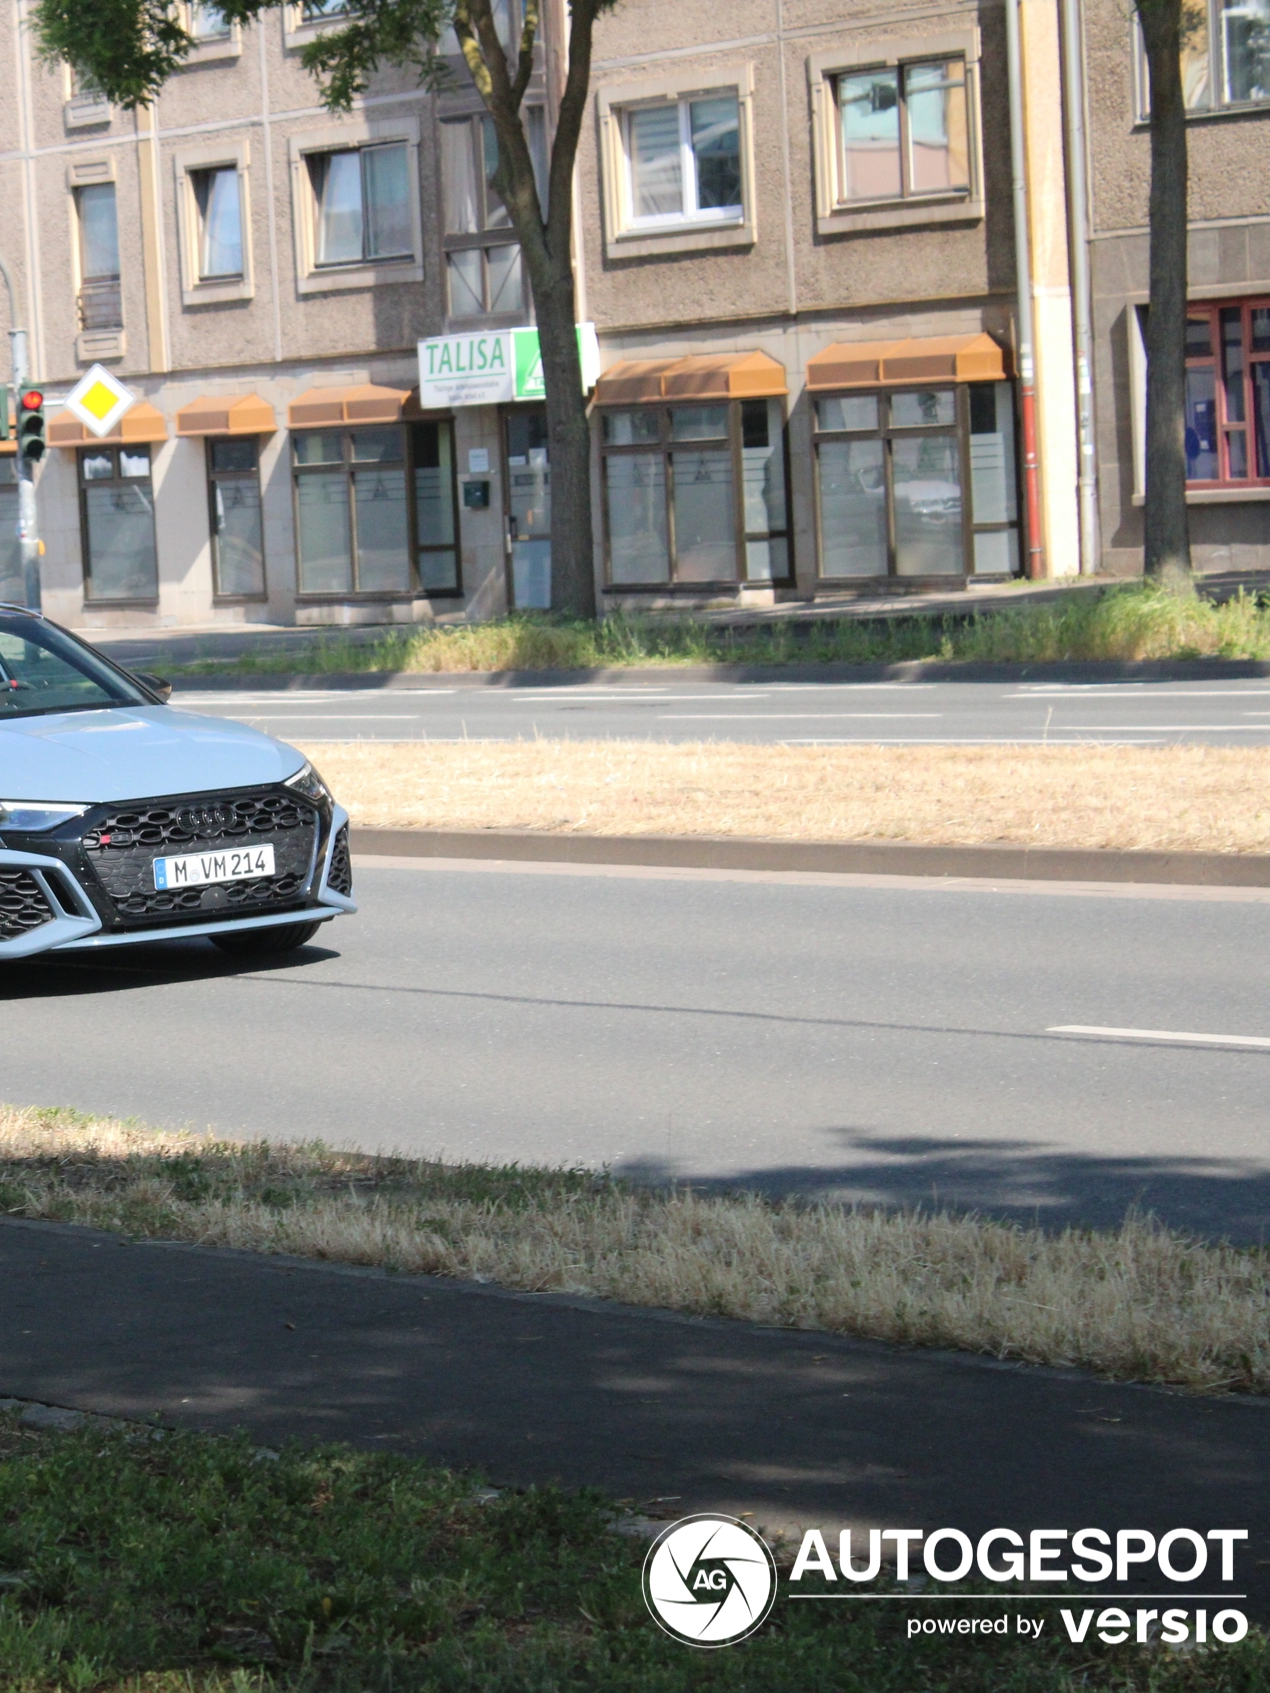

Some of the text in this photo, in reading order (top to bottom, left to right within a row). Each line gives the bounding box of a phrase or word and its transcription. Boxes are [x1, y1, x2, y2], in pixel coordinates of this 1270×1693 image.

[425, 337, 505, 375] TALISA
[158, 876, 165, 885] D
[174, 850, 265, 883] M VM 214
